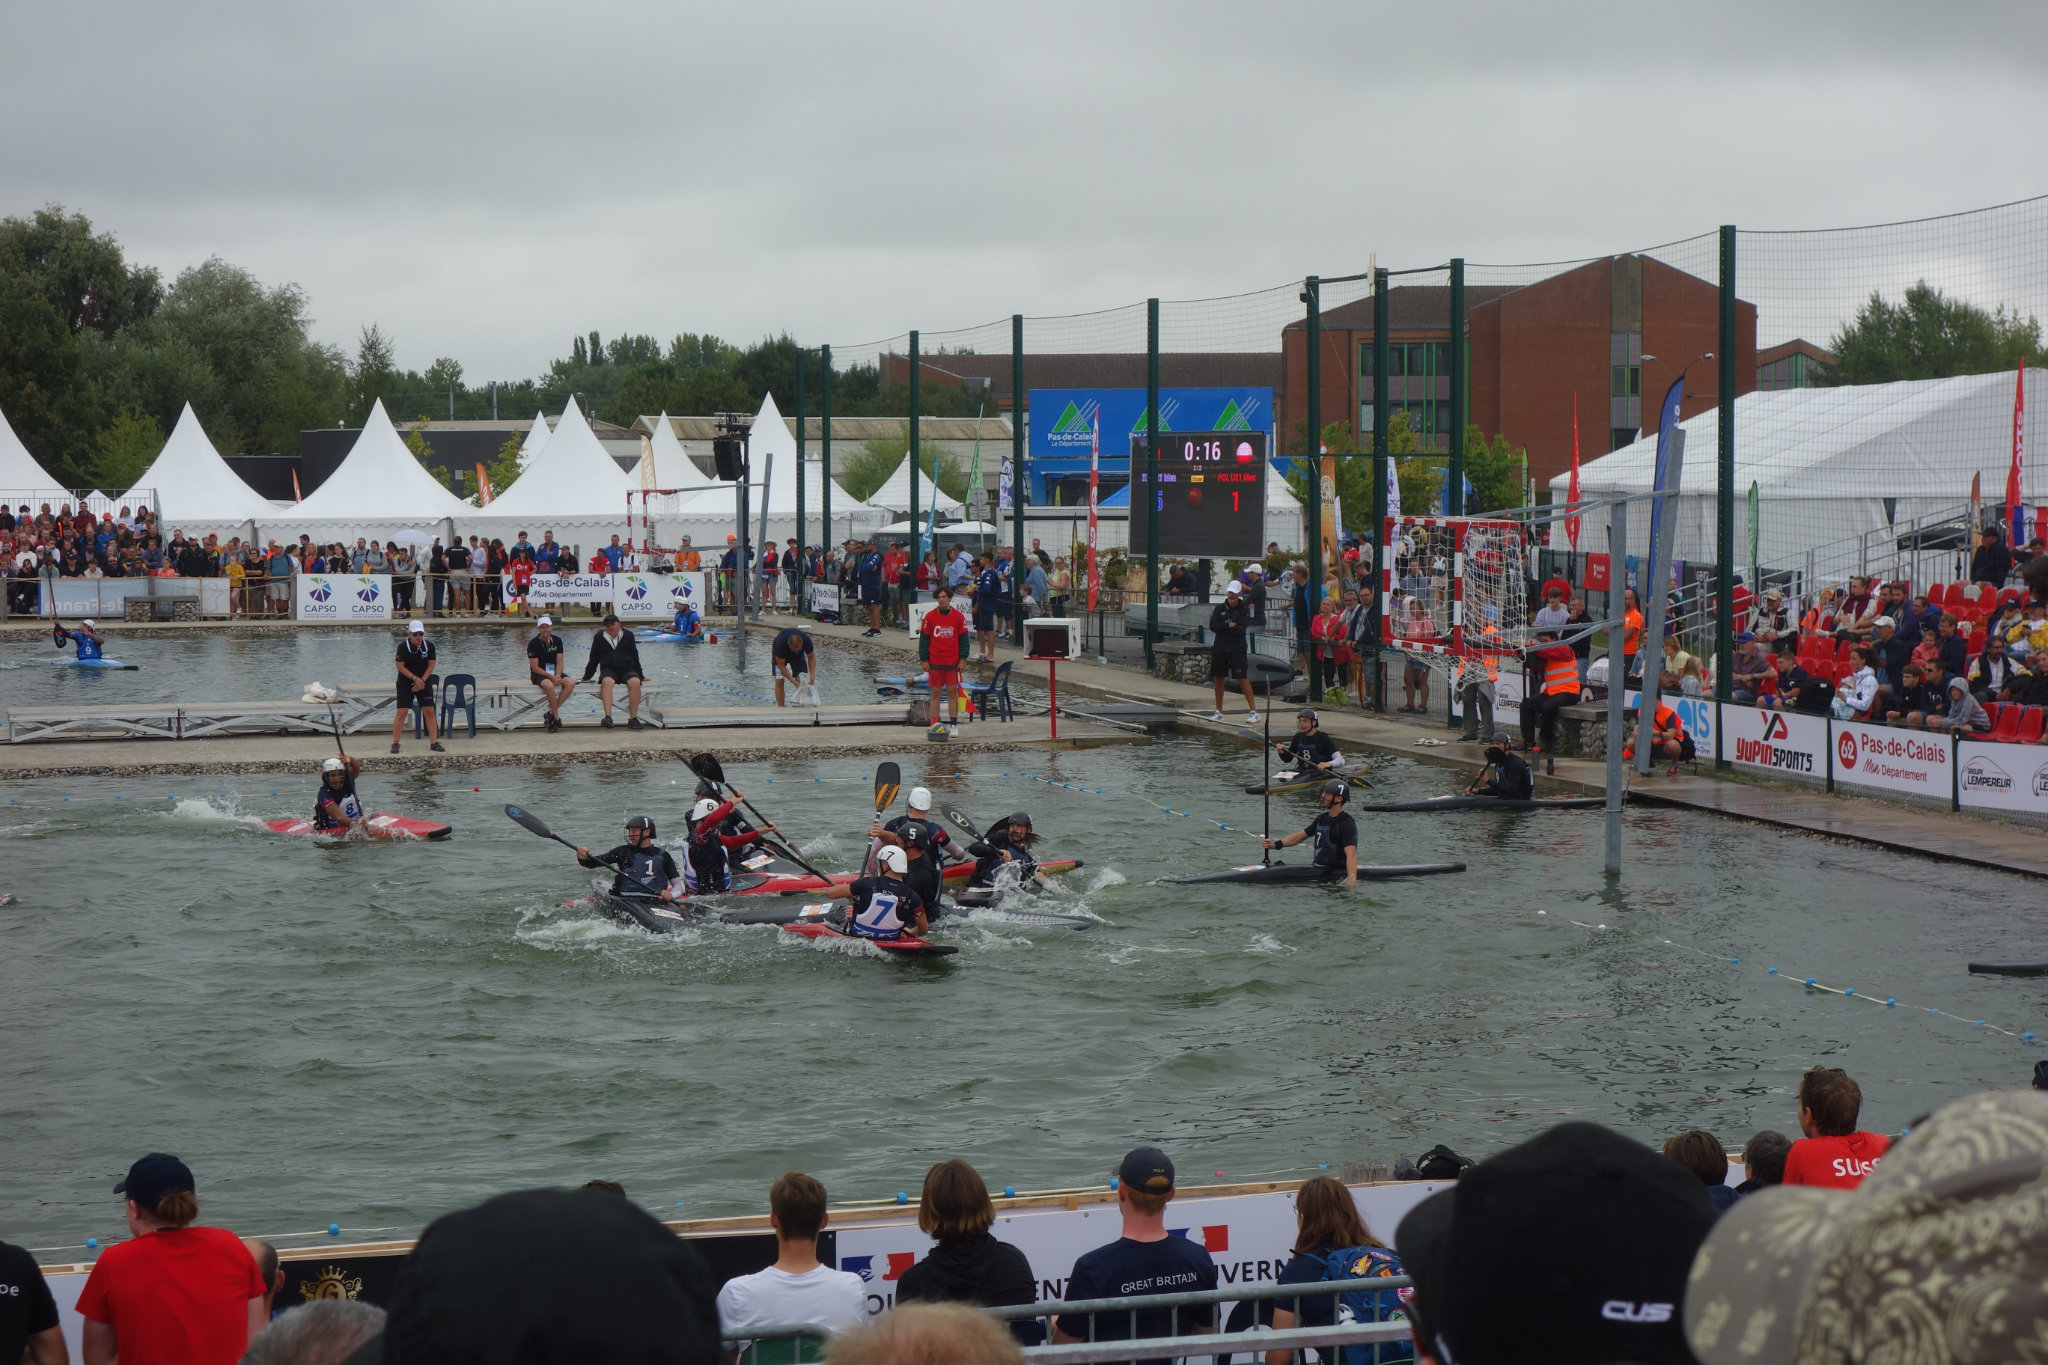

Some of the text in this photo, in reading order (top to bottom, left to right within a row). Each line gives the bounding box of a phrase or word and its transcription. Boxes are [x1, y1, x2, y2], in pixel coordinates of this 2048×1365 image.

[1184, 441, 1221, 461] 0:16
[1232, 491, 1239, 512] 1
[549, 591, 593, 599] Département
[304, 605, 337, 613] CAPSO
[352, 605, 385, 613] CAPSO
[621, 602, 653, 611] CAPSO
[1841, 740, 1855, 760] 62
[1881, 764, 1928, 782] Département
[1967, 775, 2012, 788] LEMPEREUR
[1338, 784, 1345, 796] 7
[706, 802, 714, 812] 6
[908, 828, 917, 840] 5
[886, 850, 896, 861] 7
[645, 859, 655, 876] 1
[871, 899, 895, 926] 7
[1121, 1271, 1197, 1294] GREAT BRITAIN
